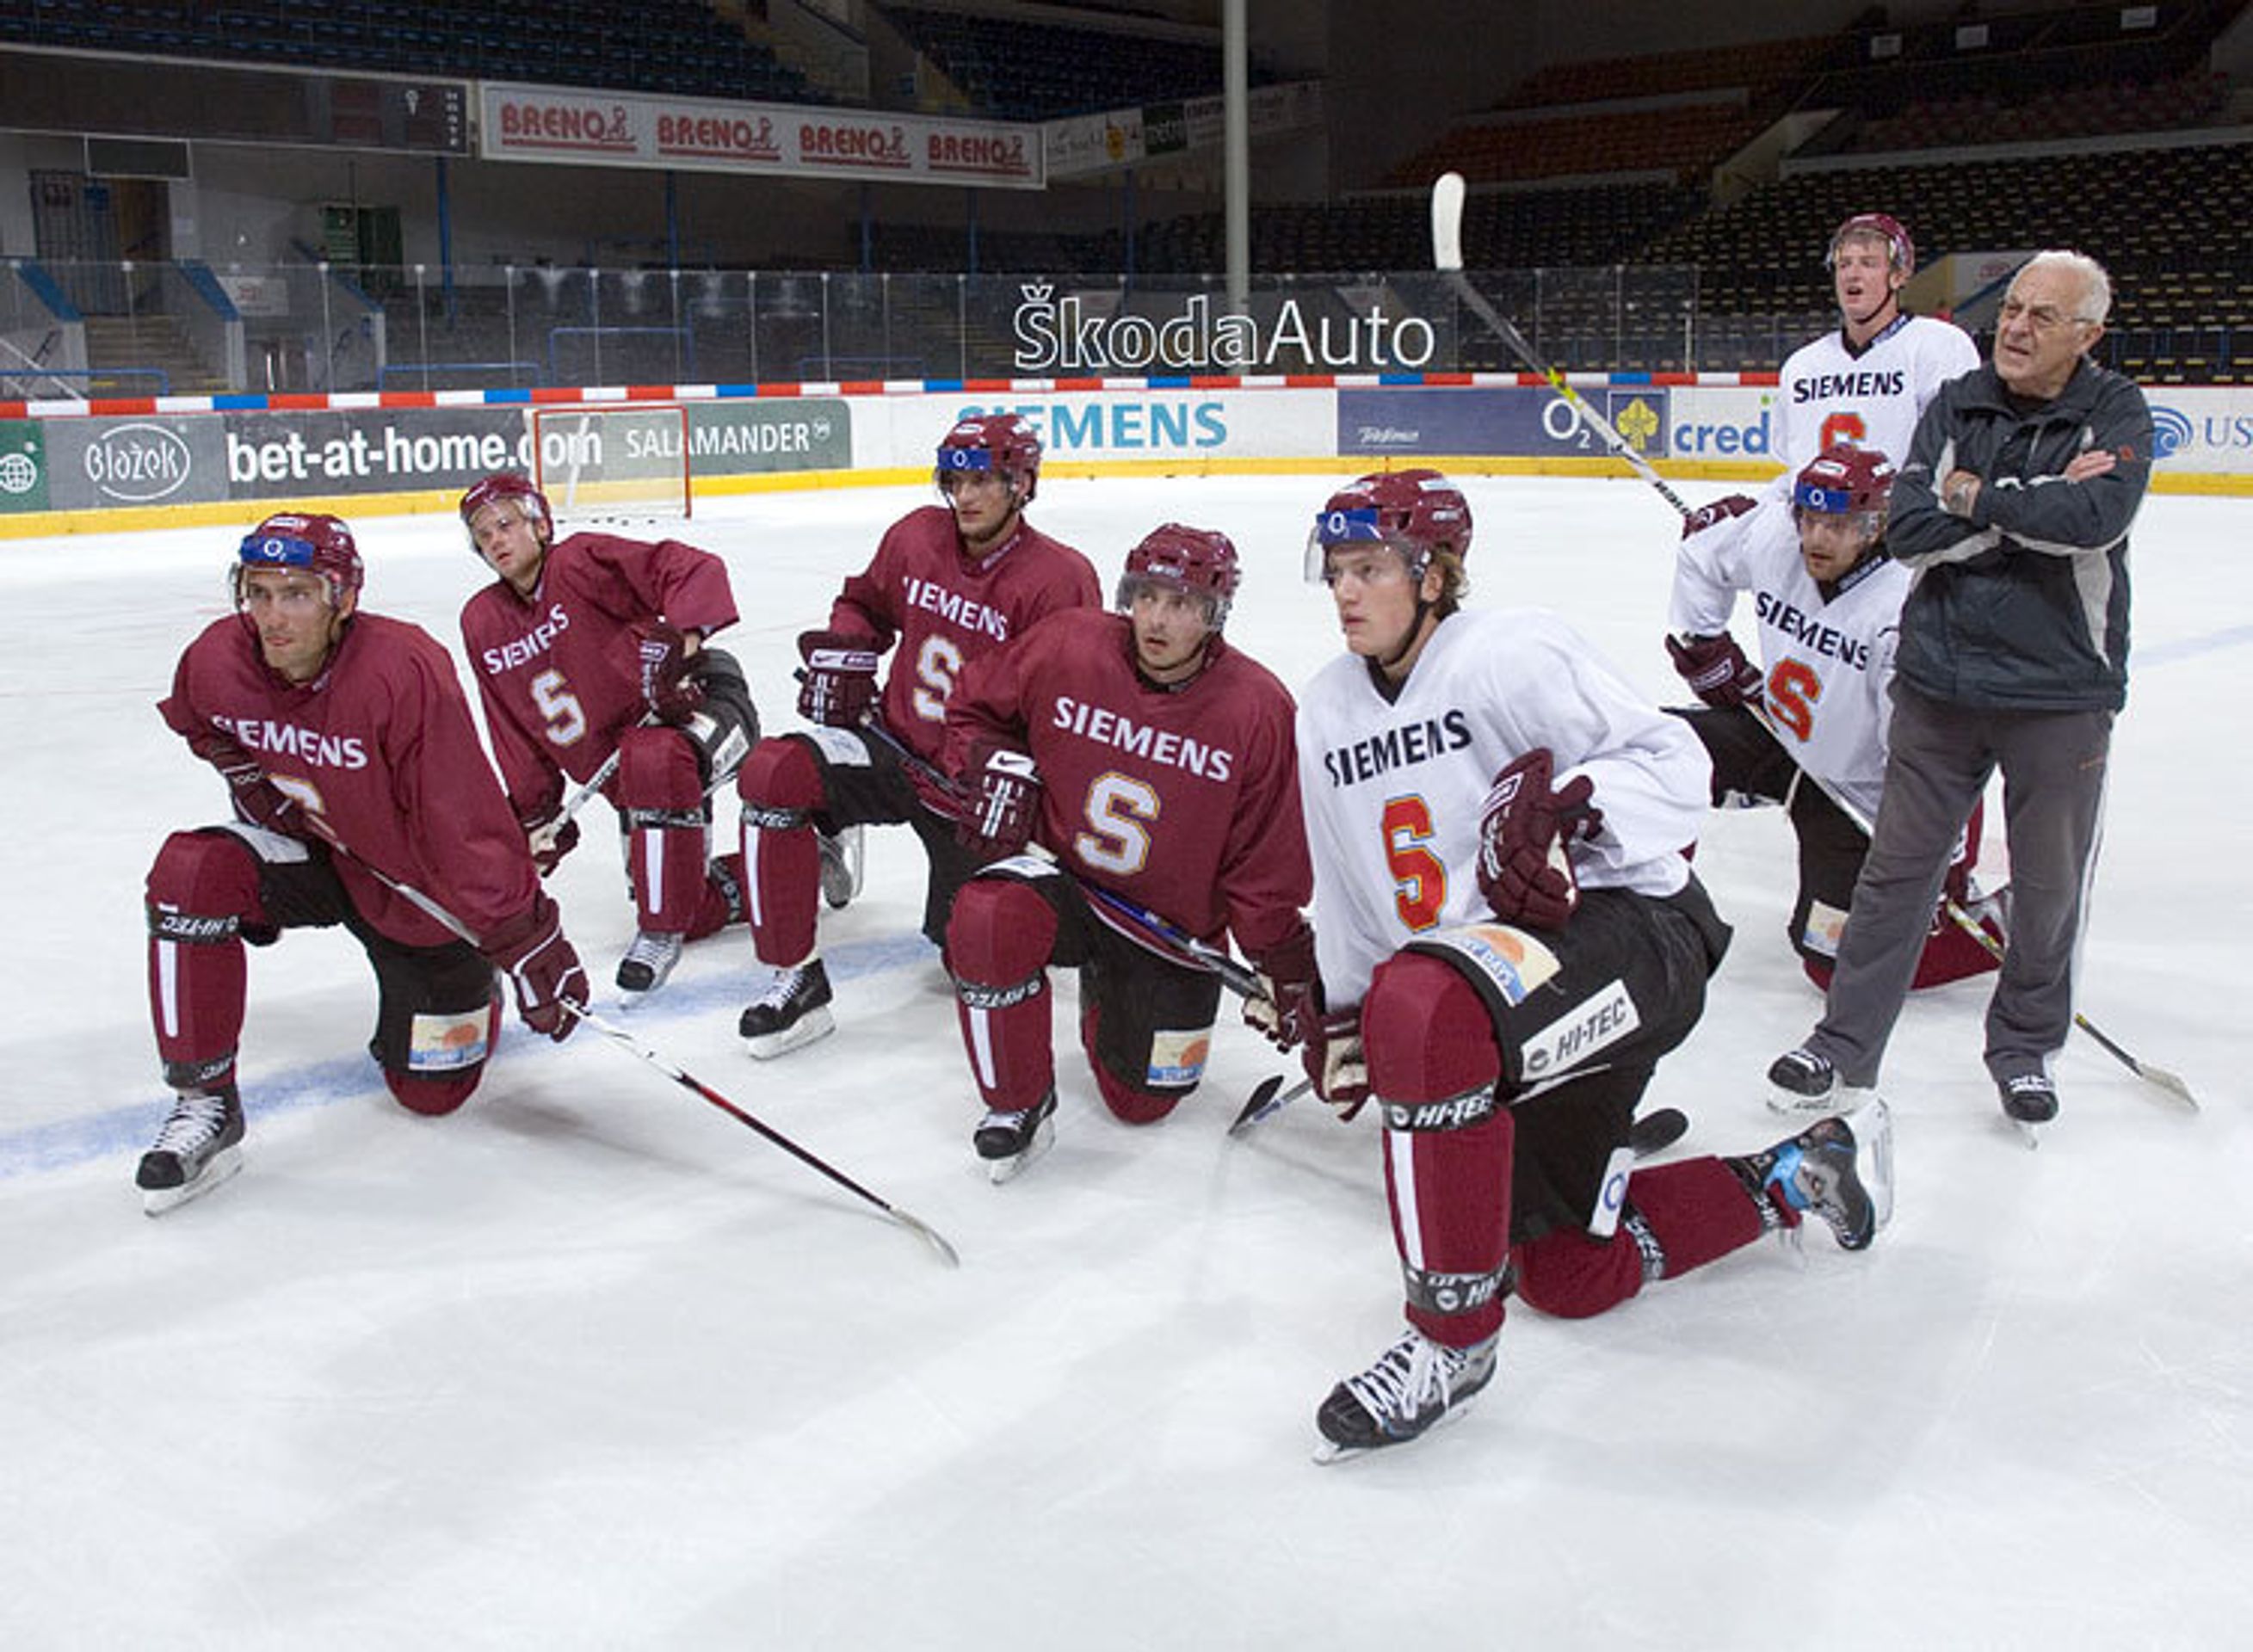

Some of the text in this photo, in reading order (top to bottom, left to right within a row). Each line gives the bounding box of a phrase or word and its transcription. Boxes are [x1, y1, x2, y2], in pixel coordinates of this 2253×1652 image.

[500, 102, 602, 140] BRENO
[657, 115, 754, 149] BRENO
[799, 124, 886, 157] BRENO
[928, 135, 1007, 163] BRENO
[1793, 369, 1904, 404] SIEMENS
[627, 422, 810, 459] SALAMANDER
[956, 403, 1227, 449] EMENS
[227, 426, 602, 484] bet-at-home.com
[902, 576, 1008, 642] IEMENS
[1756, 591, 1869, 671] SIEMENS
[1052, 695, 1233, 783] SIEMENS
[1075, 770, 1161, 876] S
